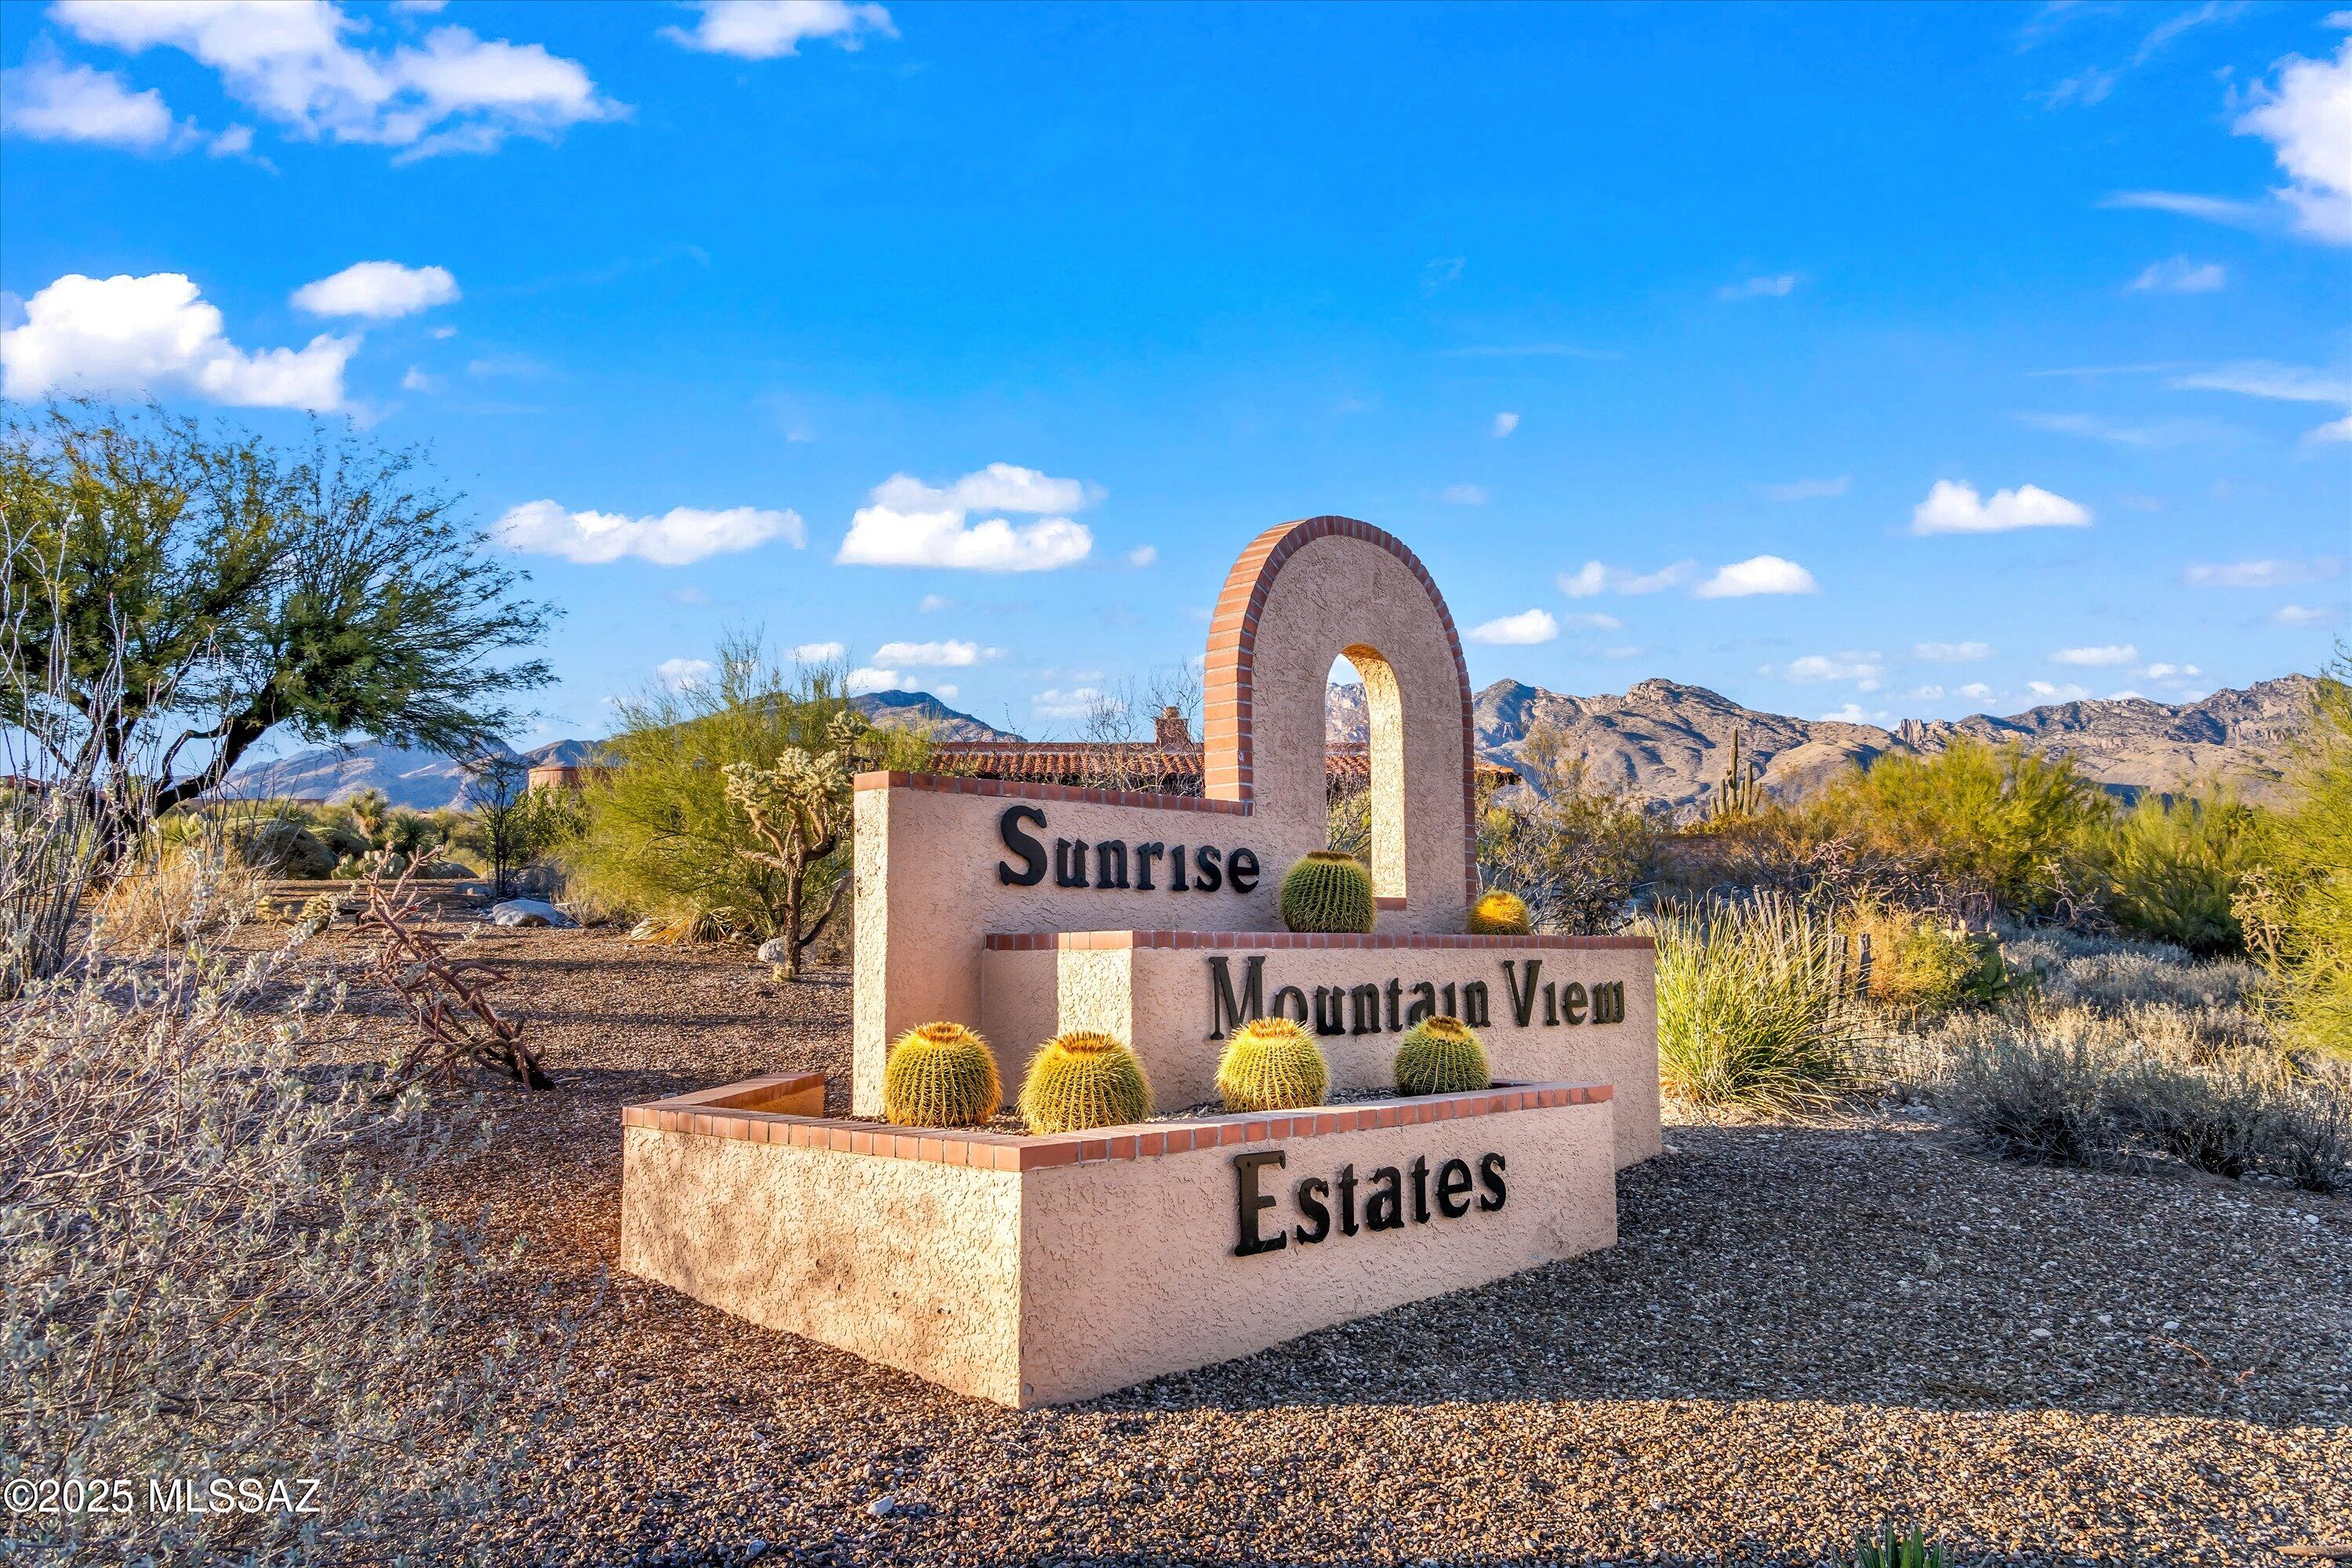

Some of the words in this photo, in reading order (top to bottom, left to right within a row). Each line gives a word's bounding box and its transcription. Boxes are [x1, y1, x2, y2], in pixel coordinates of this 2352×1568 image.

[999, 804, 1260, 894] Sunrise
[1208, 955, 1491, 1040] Mountain
[1504, 959, 1625, 1026] View
[1233, 1150, 1507, 1258] Estates
